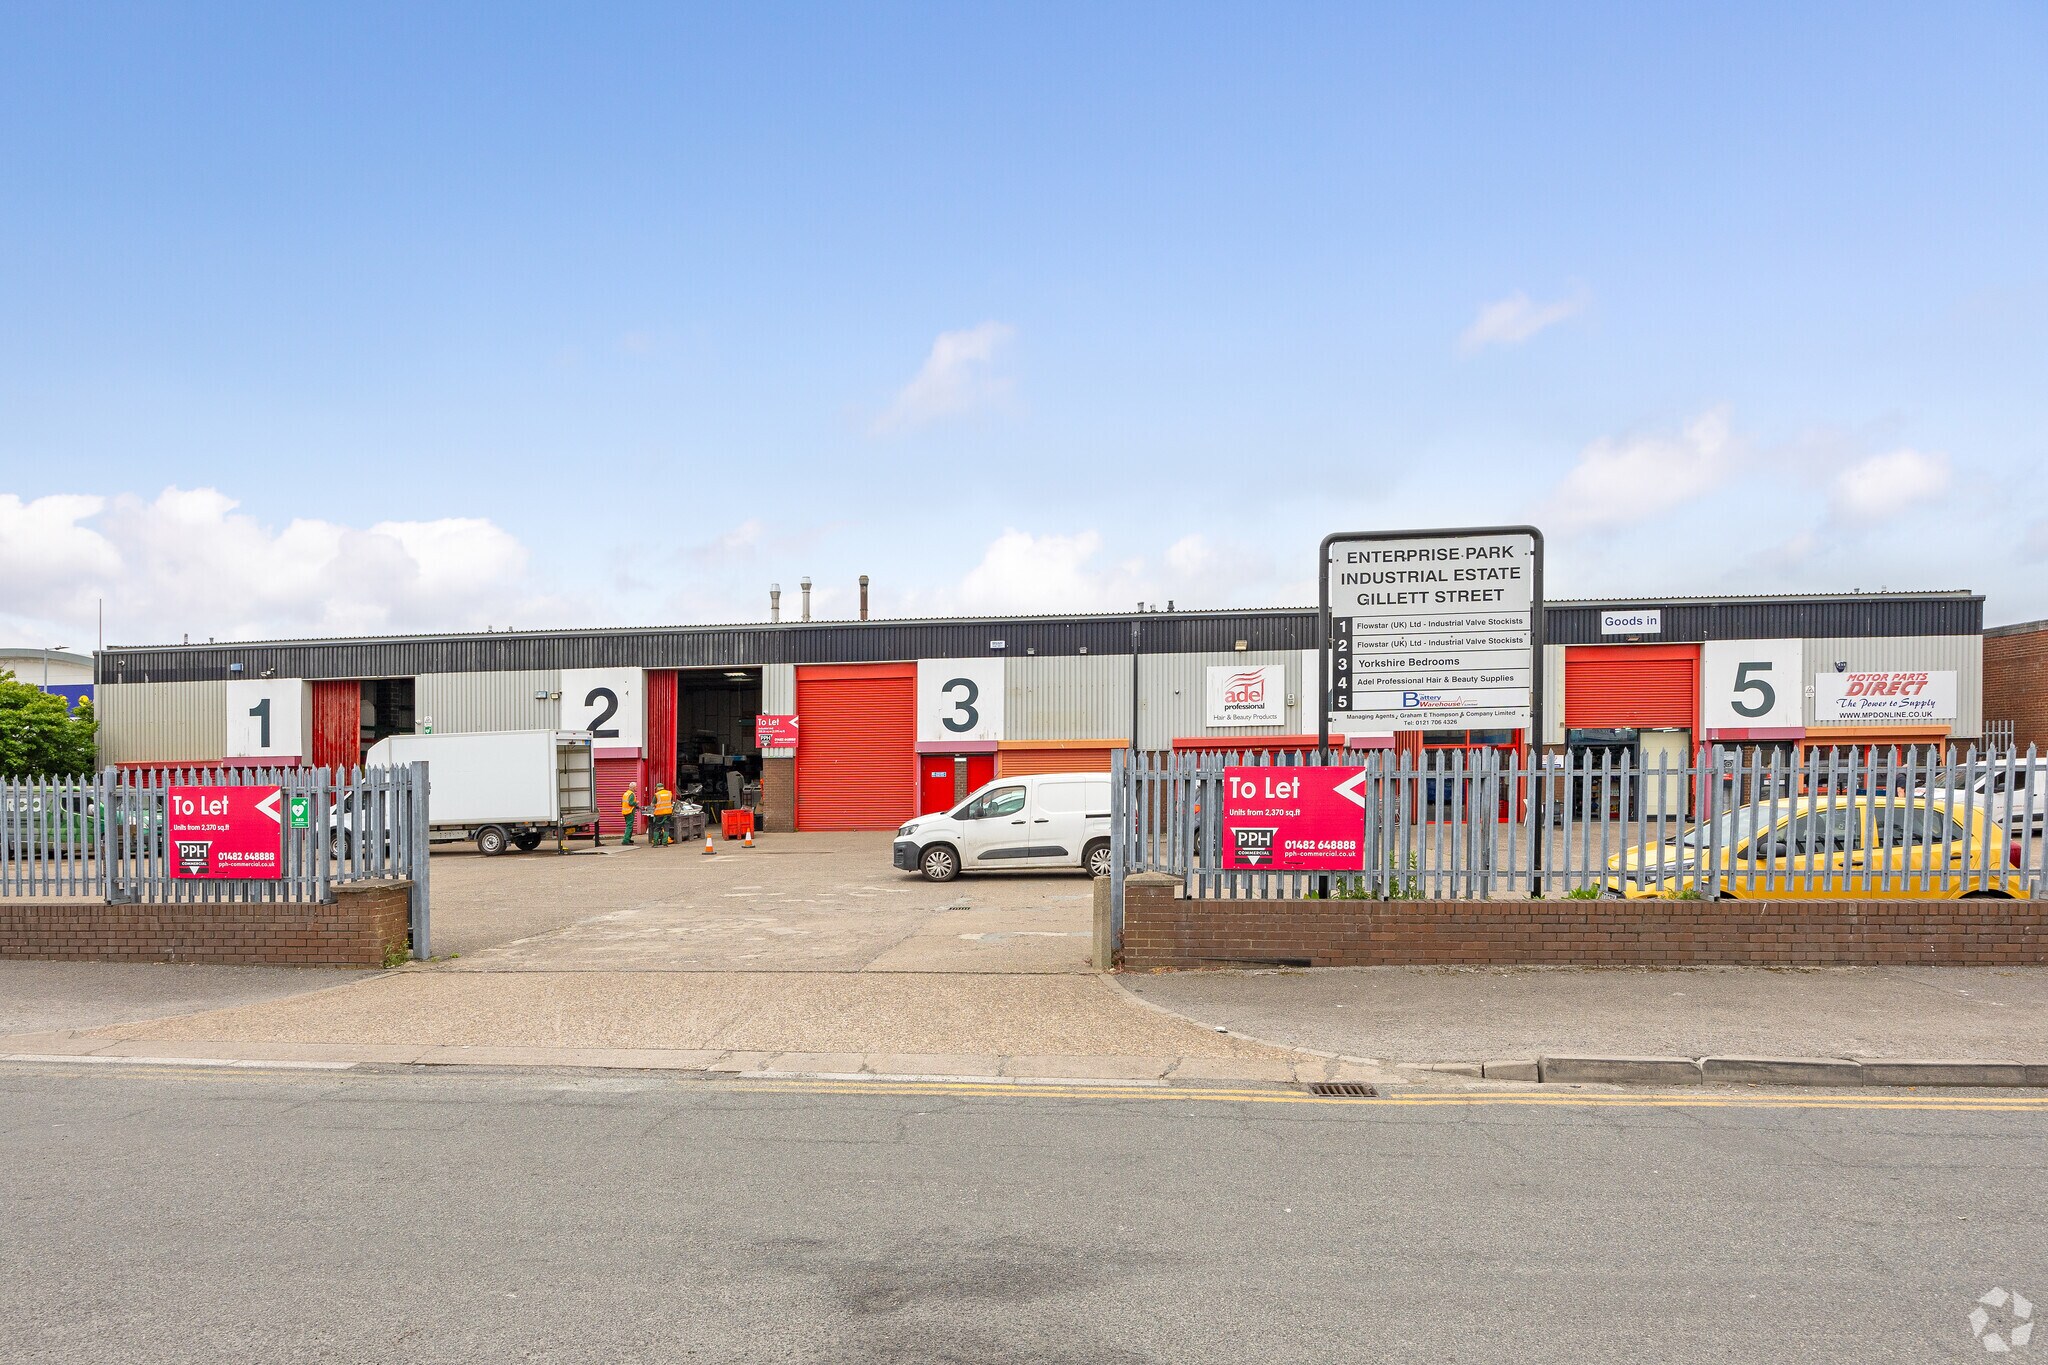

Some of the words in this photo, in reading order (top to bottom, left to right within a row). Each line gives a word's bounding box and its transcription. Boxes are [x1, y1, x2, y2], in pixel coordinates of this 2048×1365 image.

[1347, 547, 1460, 564] ENTERPRISE
[1466, 545, 1514, 560] PARK
[1341, 569, 1448, 585] INDUSTRIAL
[1454, 567, 1521, 581] ESTATE
[1357, 591, 1429, 606] GILLETT
[1434, 588, 1505, 603] STREET
[1428, 619, 1463, 627] Industrial
[1488, 618, 1523, 626] Stockists
[1605, 616, 1643, 626] Goods
[1647, 615, 1657, 625] in
[1339, 621, 1346, 633] 1
[1338, 640, 1347, 651] 2
[1488, 637, 1523, 645] Stockists
[1338, 658, 1347, 670] 3
[1359, 659, 1406, 668] Yorkshire
[1408, 658, 1460, 667] Bedrooms
[1338, 677, 1347, 689] 4
[1377, 677, 1424, 685] Professional
[1480, 675, 1514, 683] Supplies
[1846, 673, 1889, 682] MOTOR
[1892, 672, 1928, 681] PARTS
[1225, 679, 1265, 702] adel
[1730, 661, 1776, 718] 5
[1845, 680, 1929, 697] DIRECT
[941, 677, 980, 733] 3
[1224, 703, 1265, 711] professional
[1338, 695, 1347, 708] 5
[1836, 698, 1857, 708] The
[1859, 698, 1887, 709] Power
[1889, 699, 1898, 707] to
[1899, 697, 1936, 709] Supply
[584, 687, 620, 739] 2
[249, 697, 272, 748] 1
[757, 718, 767, 726] To
[768, 718, 780, 726] Let
[1229, 776, 1257, 799] To
[1265, 776, 1301, 799] Let
[172, 795, 195, 816] To
[201, 795, 229, 815] Let
[1229, 808, 1246, 816] Units
[1247, 808, 1264, 816] from
[1265, 808, 1284, 817] 2,370
[1285, 808, 1301, 818] sq.ft
[1237, 831, 1270, 846] PPH
[181, 844, 208, 858] PPH
[1284, 840, 1316, 850] 01482
[1317, 840, 1356, 850] 648888
[217, 852, 243, 861] 01482
[244, 852, 275, 861] 648888
[1284, 850, 1356, 858] pph-commercial.co.uk
